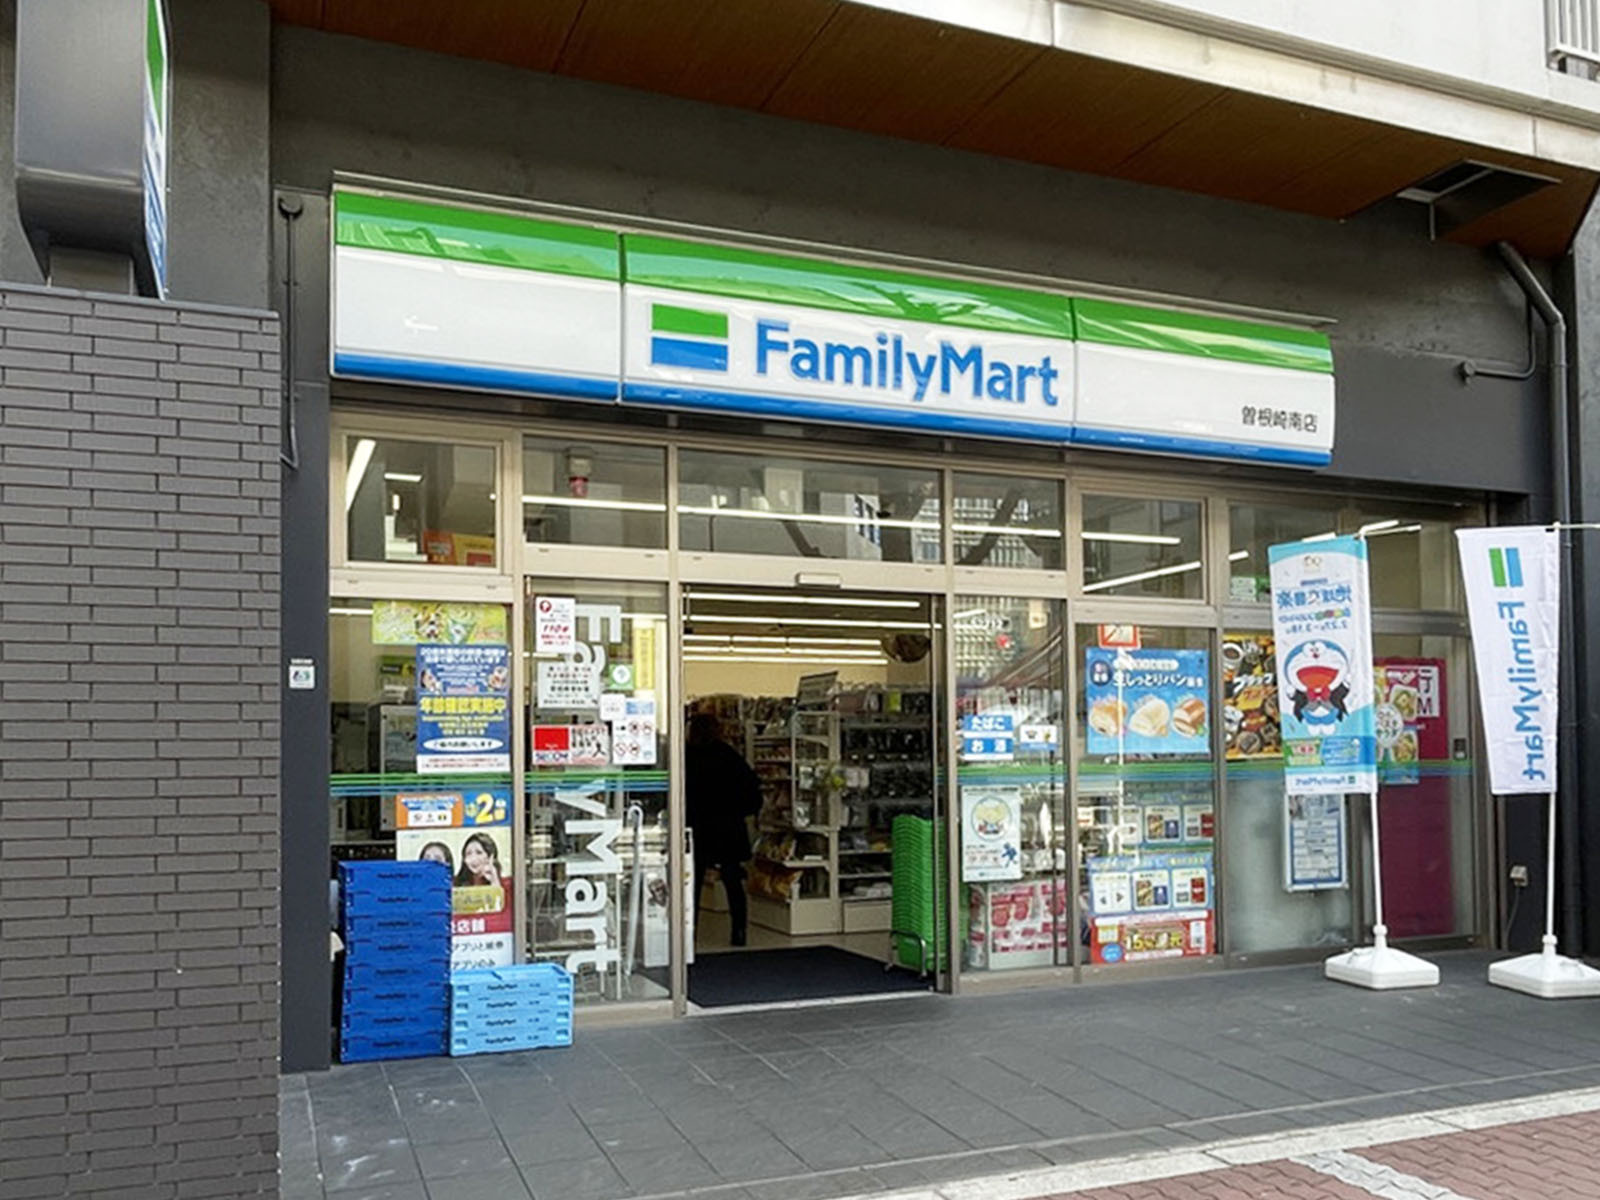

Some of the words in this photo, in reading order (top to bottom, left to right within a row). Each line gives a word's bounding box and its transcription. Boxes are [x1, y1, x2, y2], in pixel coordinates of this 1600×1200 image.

[756, 318, 1058, 407] FamilyMart
[971, 715, 1006, 731] たばこ
